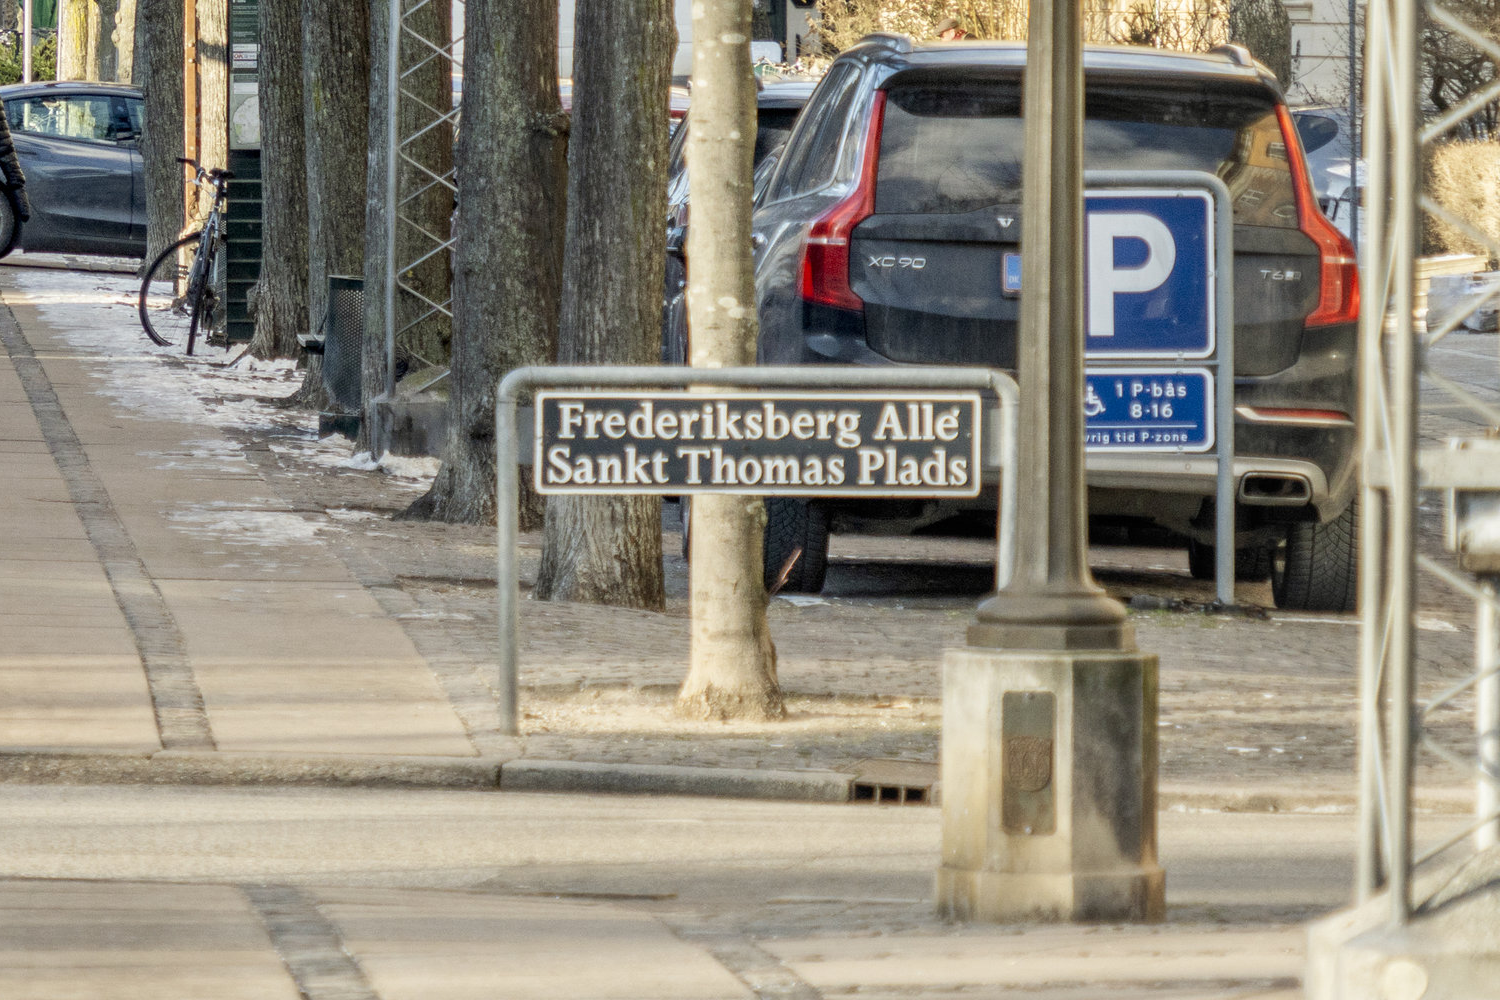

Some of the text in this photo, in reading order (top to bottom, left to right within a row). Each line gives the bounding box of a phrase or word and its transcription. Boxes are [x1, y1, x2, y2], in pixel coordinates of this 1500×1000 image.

[1087, 213, 1177, 337] P
[1116, 382, 1187, 398] 1 P-bås
[1131, 403, 1174, 418] 8-16
[557, 402, 960, 448] Frederiksberg Allé
[1116, 432, 1136, 442] tid
[1142, 432, 1188, 442] P-zone
[547, 446, 968, 487] Sankt Thomas Plads
